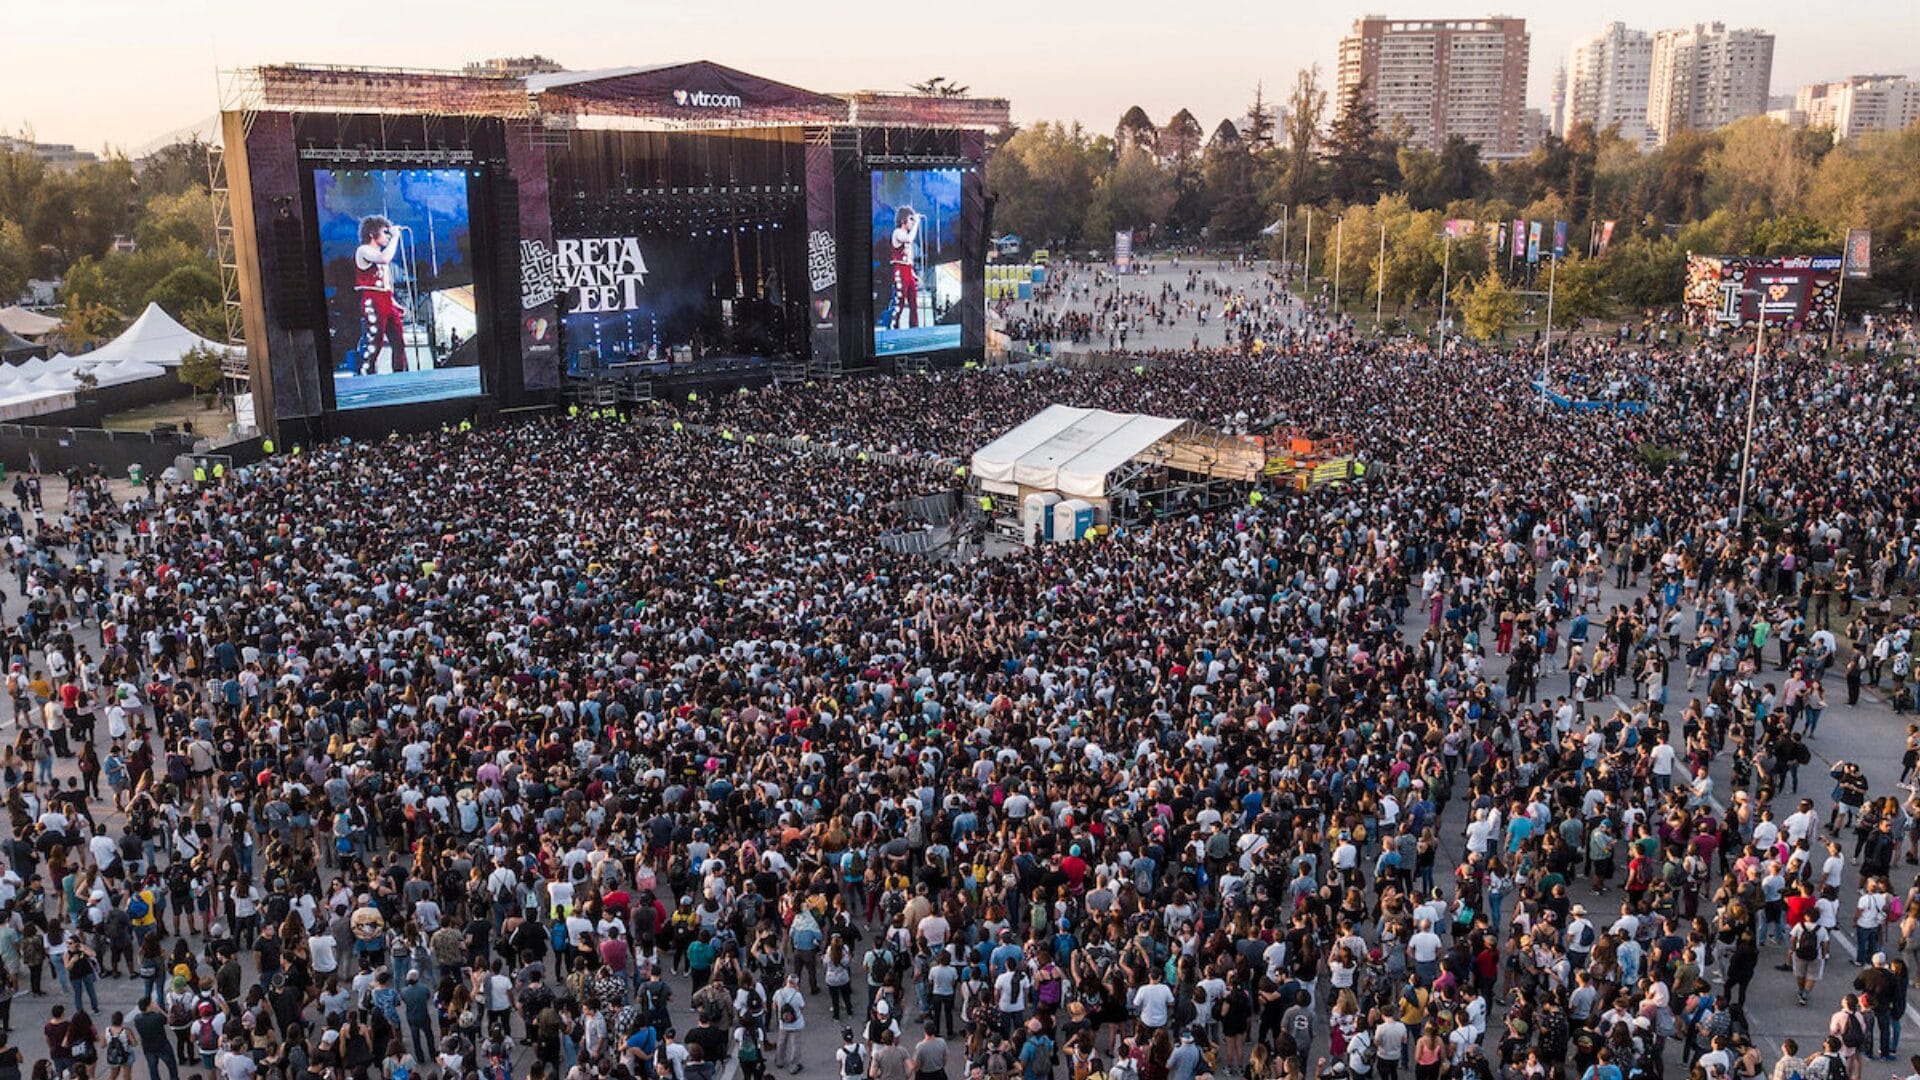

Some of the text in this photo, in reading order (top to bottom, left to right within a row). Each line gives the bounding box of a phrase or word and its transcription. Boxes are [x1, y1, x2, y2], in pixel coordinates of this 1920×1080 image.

[689, 90, 741, 108] vtr.com
[552, 237, 649, 275] RETA
[558, 264, 615, 288] VAN
[567, 273, 645, 314] EET
